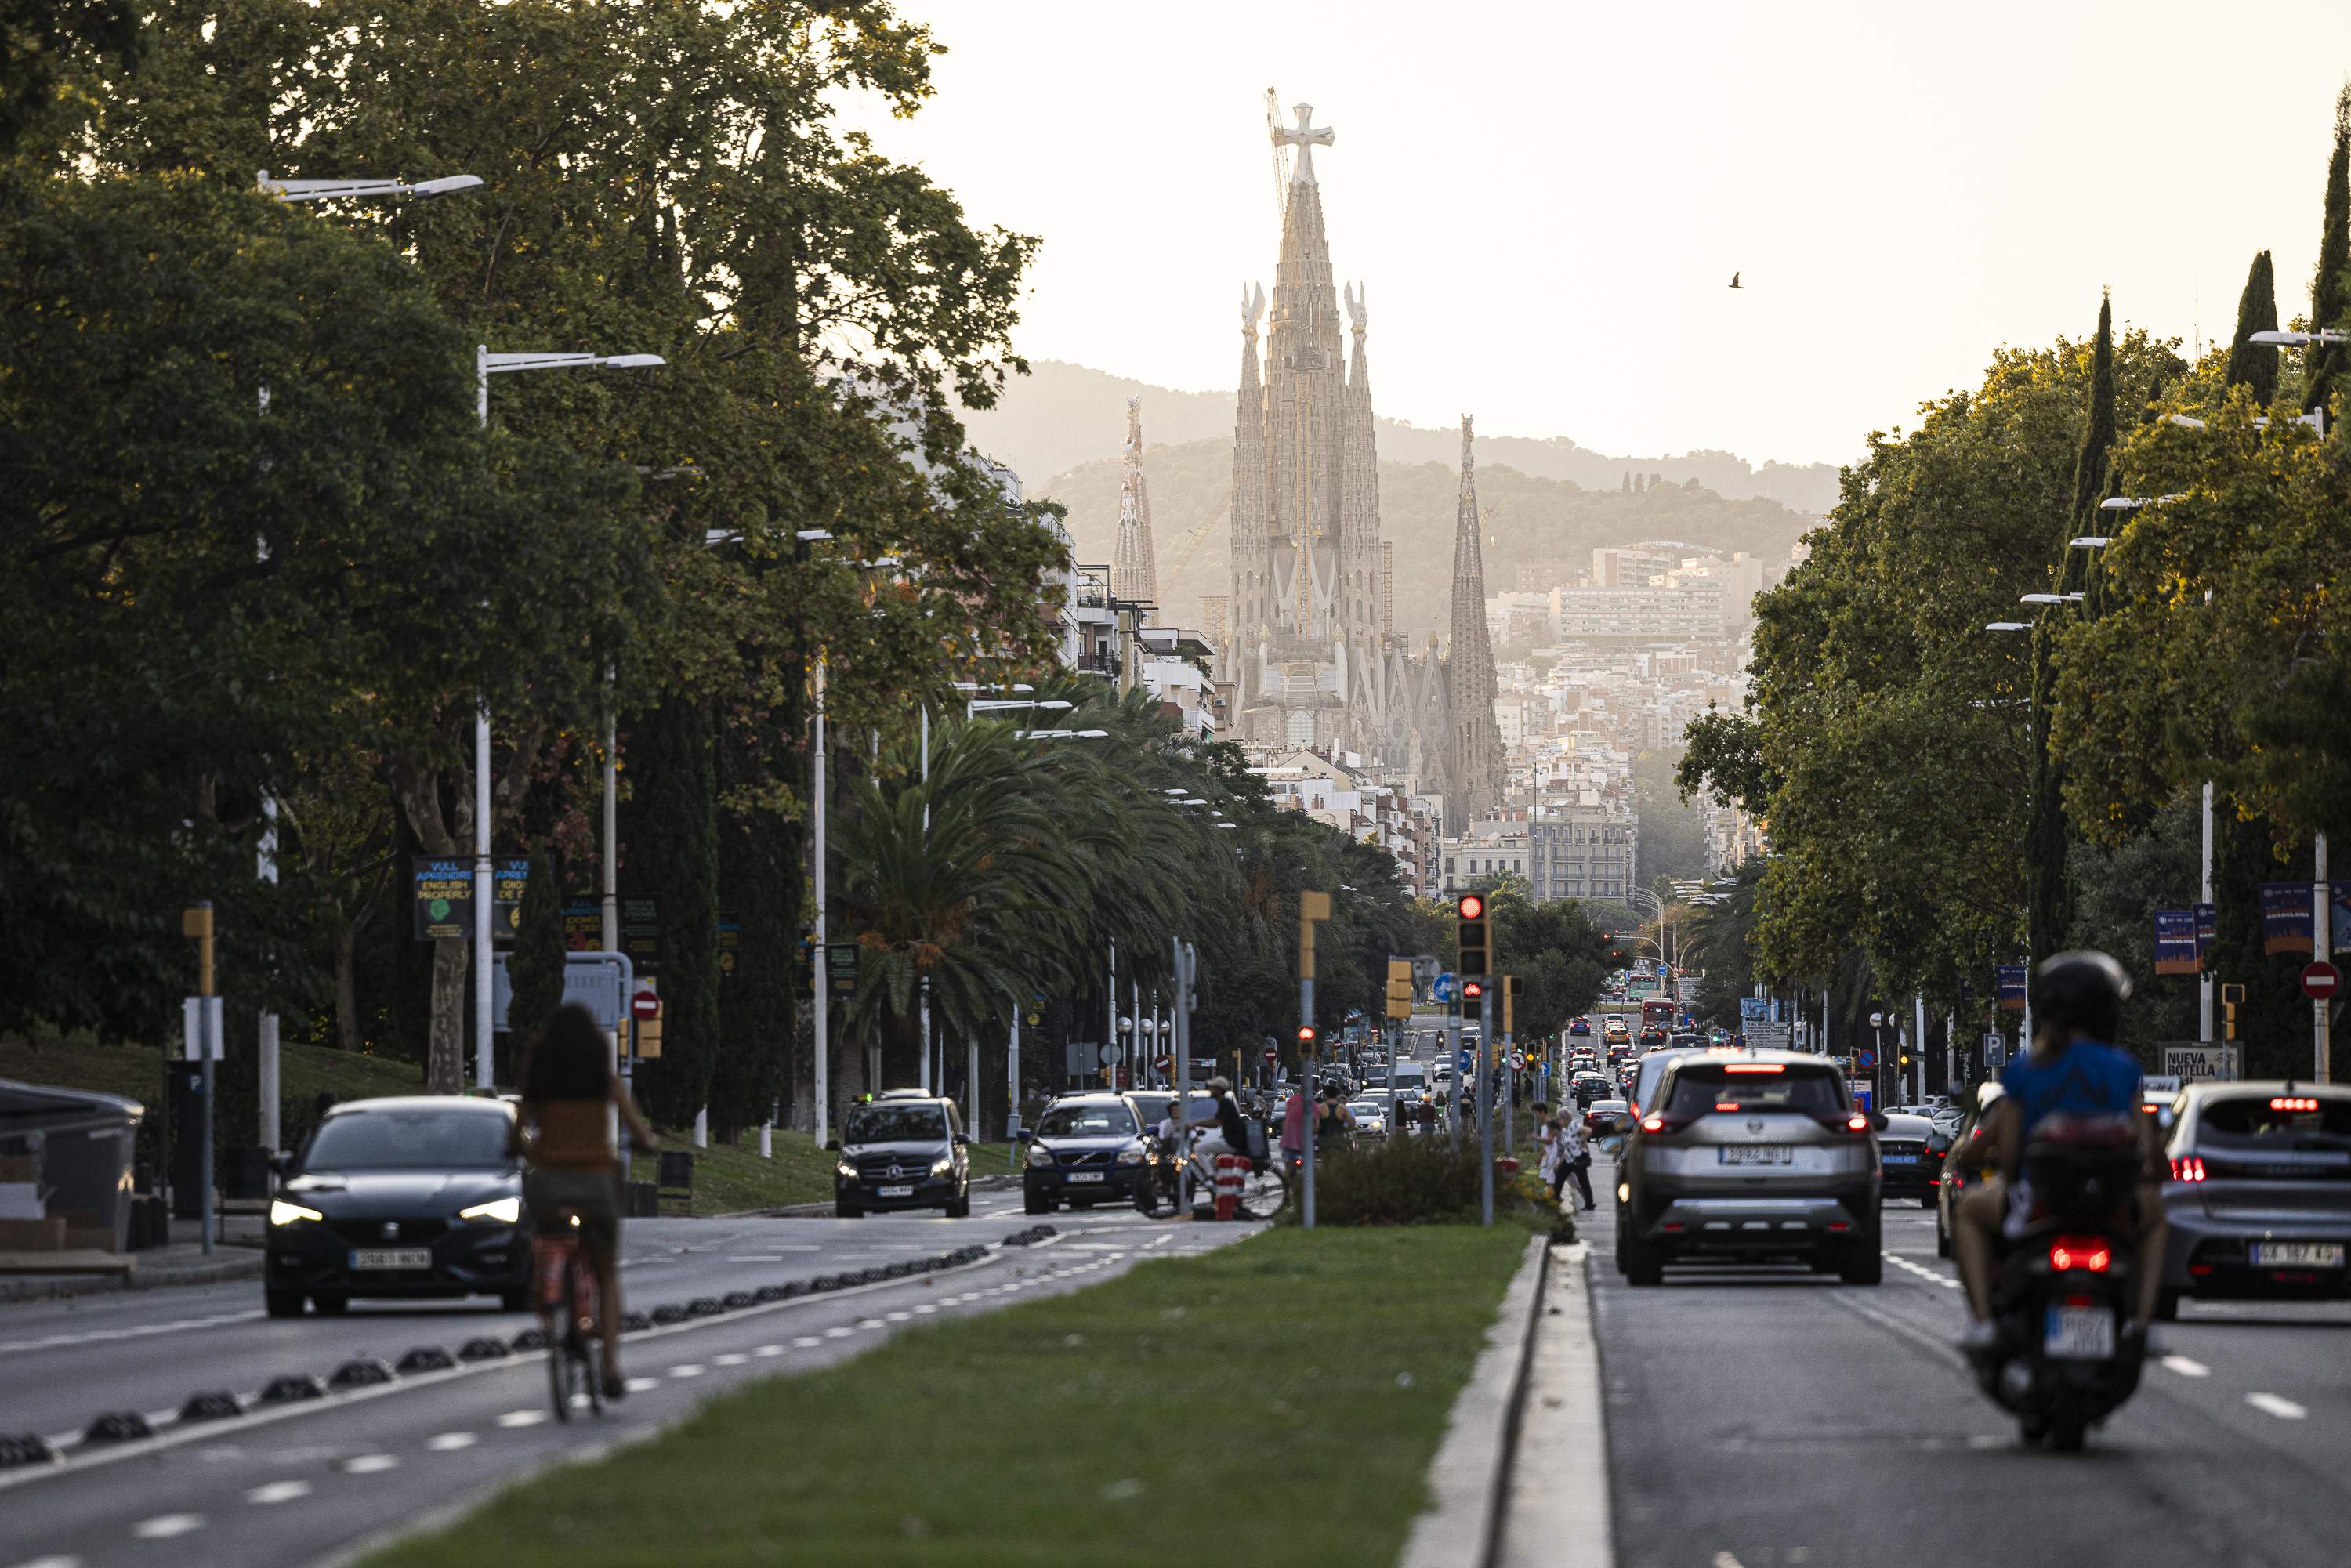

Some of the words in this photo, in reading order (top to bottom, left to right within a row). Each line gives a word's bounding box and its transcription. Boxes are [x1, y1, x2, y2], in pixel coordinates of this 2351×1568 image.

[432, 861, 458, 871] VULL
[415, 871, 473, 881] APRENDRE
[422, 881, 469, 890] ENGLISH
[416, 890, 473, 900] PROPERLY
[1988, 1036, 2001, 1054] P
[2168, 1052, 2206, 1064] NUEVA
[2168, 1064, 2215, 1076] BOTELLA
[190, 1074, 201, 1091] P
